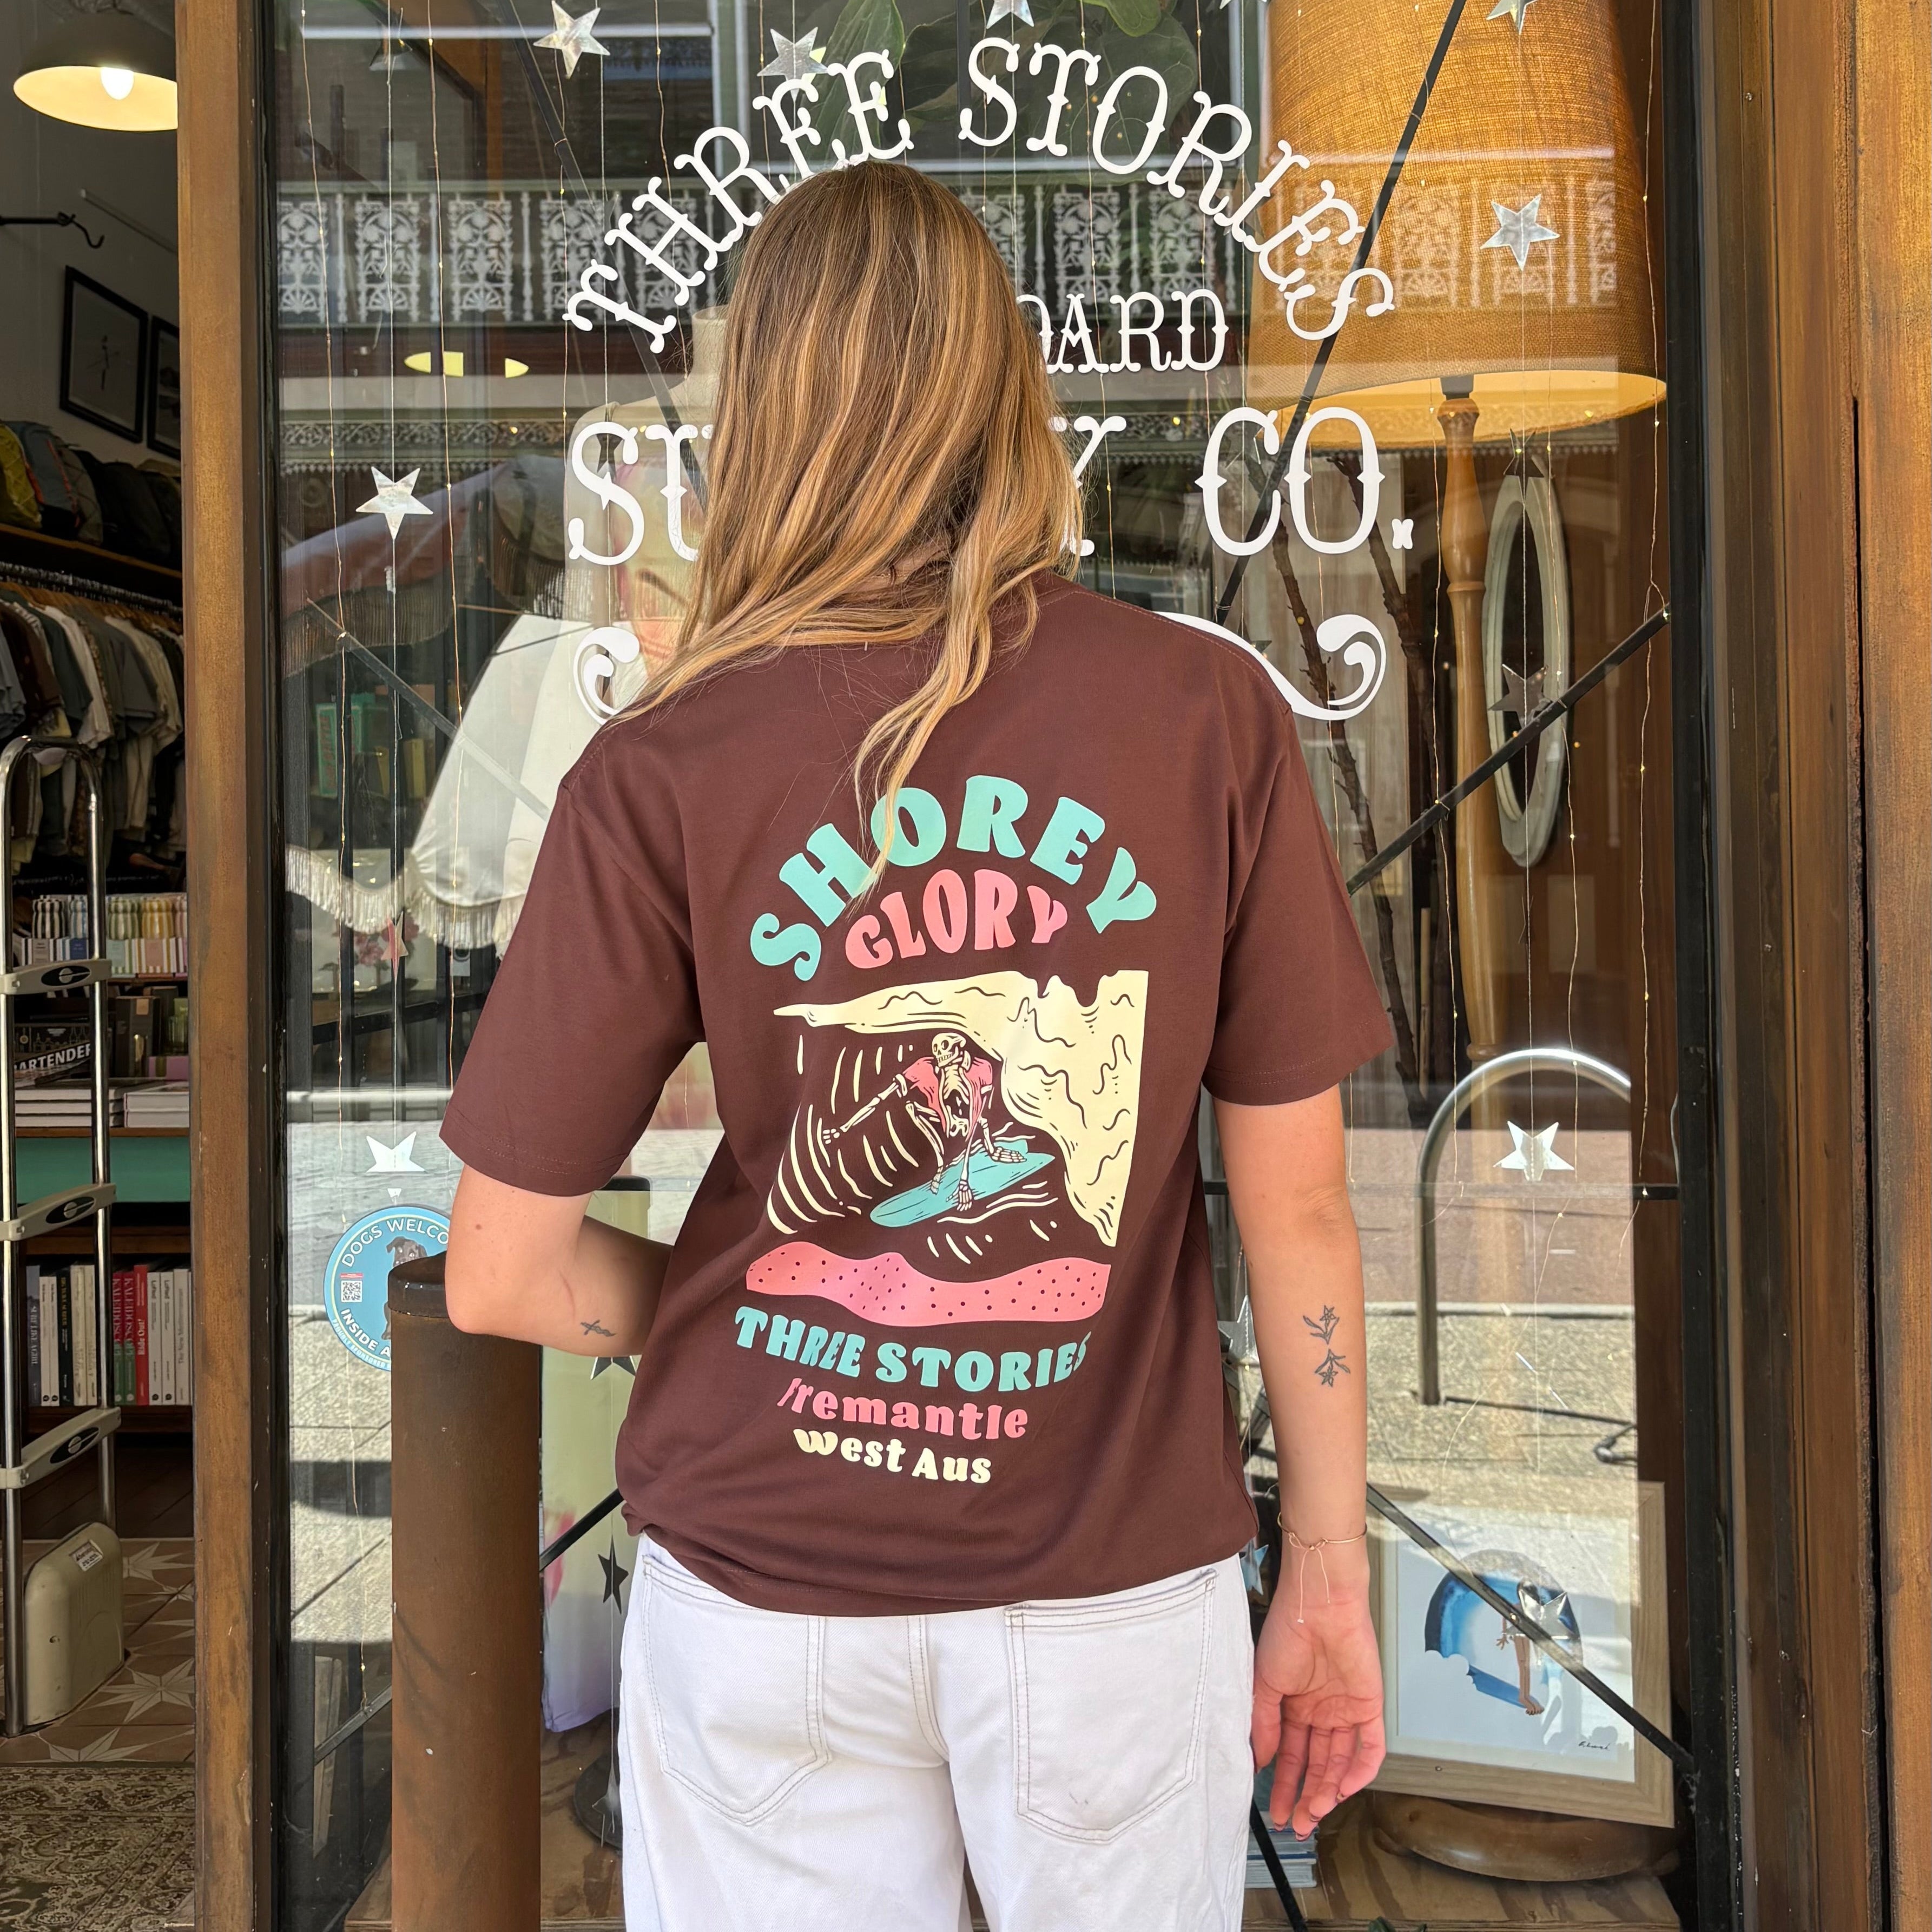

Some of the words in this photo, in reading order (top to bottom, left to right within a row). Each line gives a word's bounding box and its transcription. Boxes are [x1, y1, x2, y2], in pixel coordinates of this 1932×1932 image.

[562, 49, 914, 354] THREE
[958, 36, 1394, 341] STORIES
[1194, 406, 1414, 556] CO.
[750, 775, 1157, 981] SHOREY
[845, 868, 1069, 969] GLORY
[341, 1225, 383, 1268] DOGS
[386, 1218, 450, 1245] WELCO
[340, 1308, 379, 1351] INSIDE
[735, 1305, 866, 1377] THREE
[793, 1428, 906, 1473] west
[912, 1447, 992, 1484] Aus
